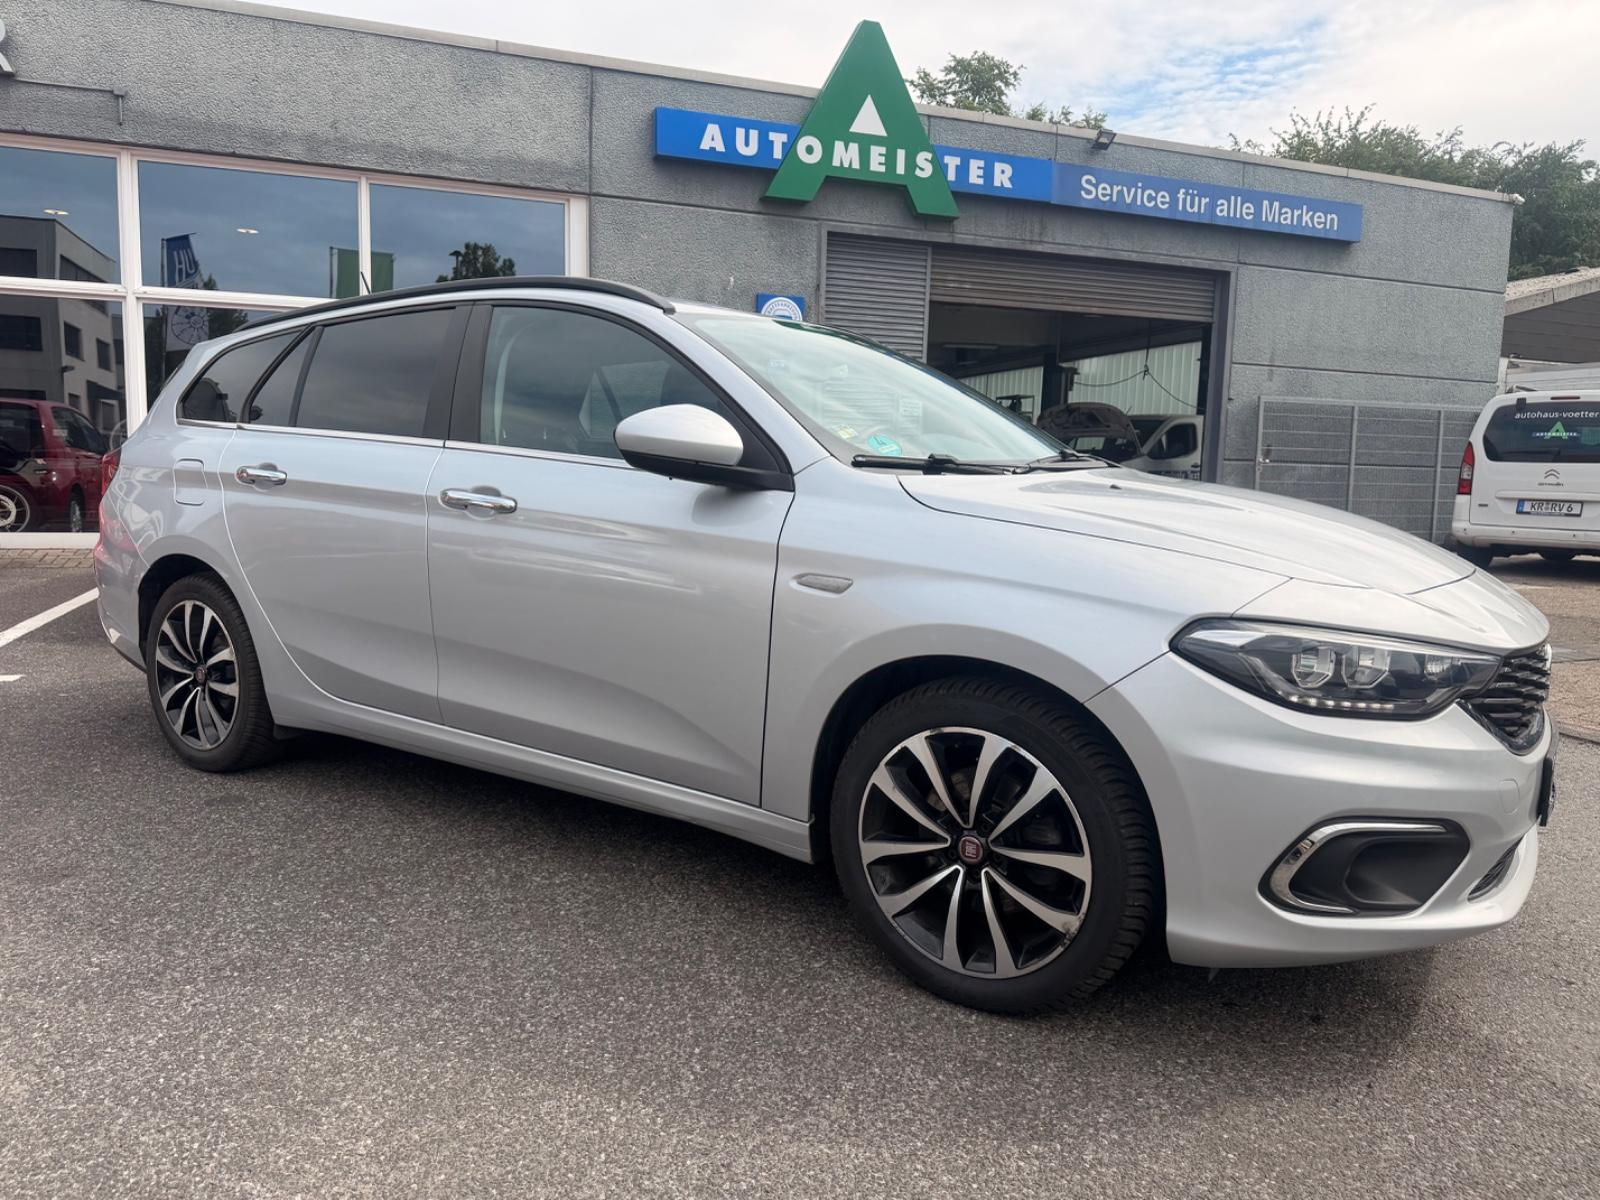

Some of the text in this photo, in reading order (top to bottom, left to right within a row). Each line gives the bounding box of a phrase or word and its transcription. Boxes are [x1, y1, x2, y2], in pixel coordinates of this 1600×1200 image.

[699, 122, 1013, 189] AUTOMEISTER
[1080, 173, 1339, 231] Service für alle Marken
[1530, 502, 1573, 512] KR RV 6
